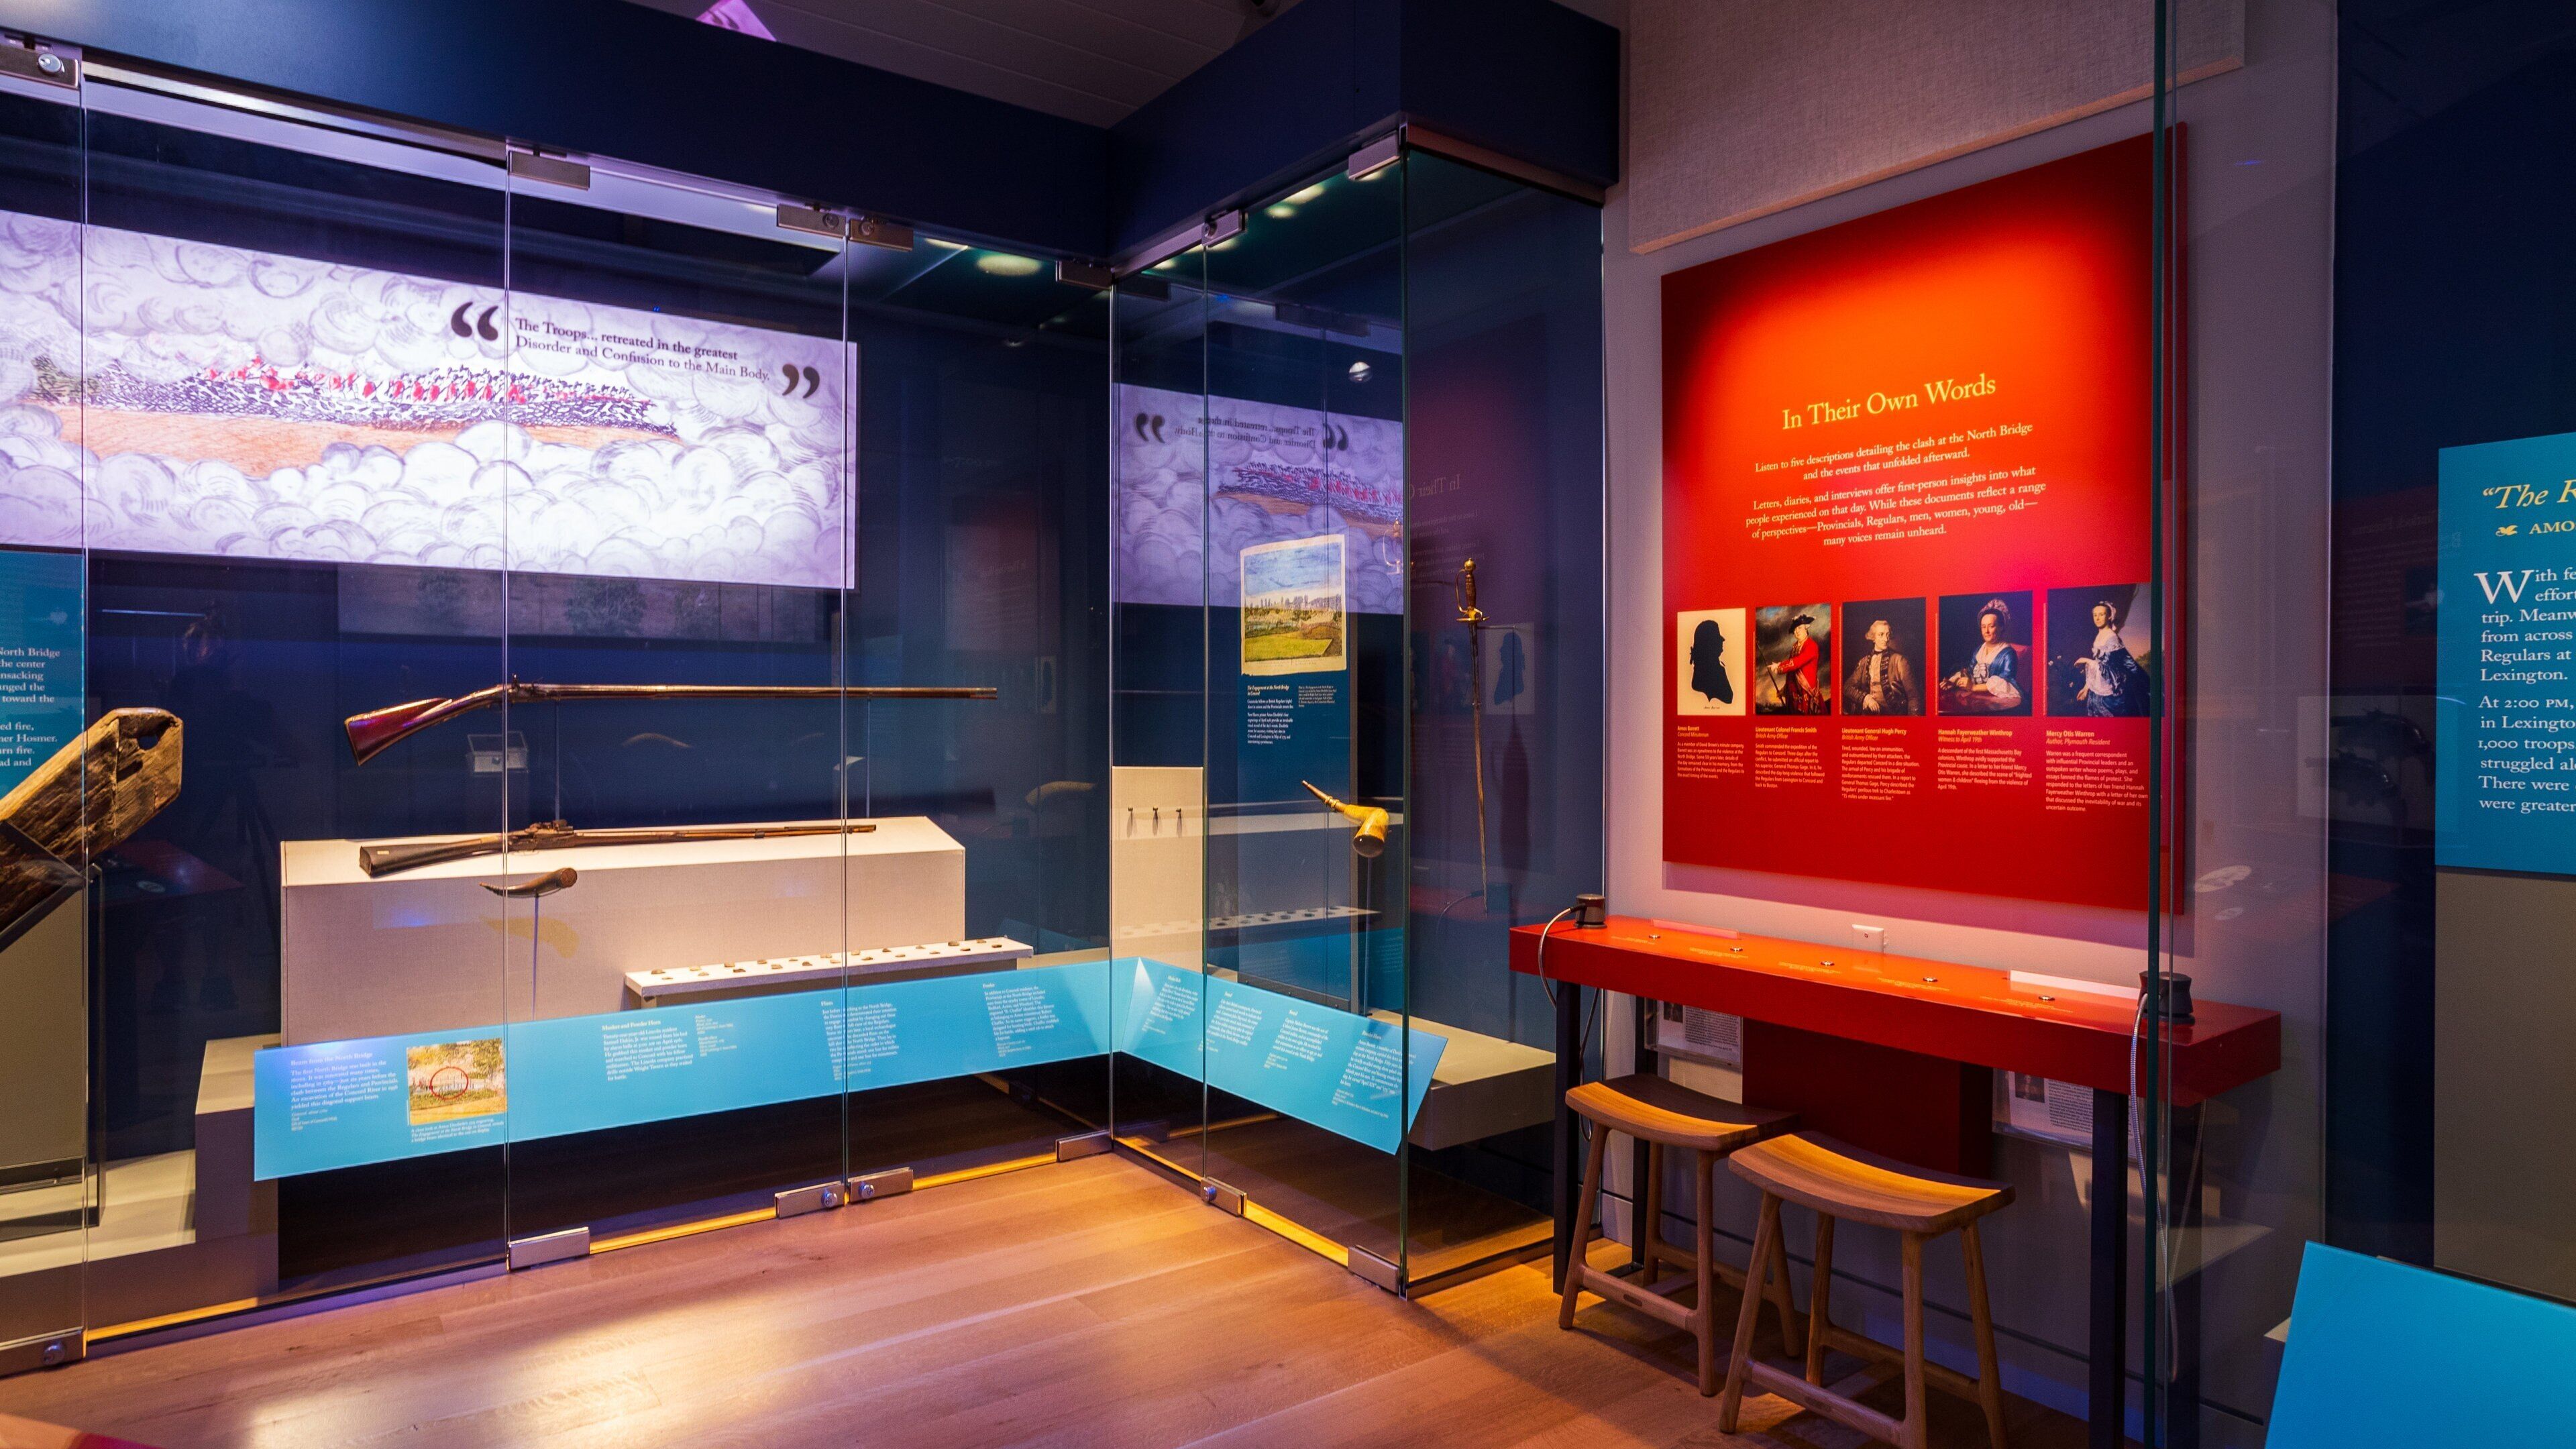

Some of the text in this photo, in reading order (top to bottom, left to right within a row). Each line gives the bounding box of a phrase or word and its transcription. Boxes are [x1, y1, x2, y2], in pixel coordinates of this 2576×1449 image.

[515, 317, 737, 360] The Troops... retreated in the greatest
[516, 334, 769, 382] Disorder and Confusion to the Main Body.
[1782, 372, 1995, 429] In Their Own Words
[1756, 462, 1778, 472] Listen
[1790, 457, 1804, 467] five
[1806, 451, 1854, 464] descriptions
[1856, 444, 1893, 457] detailing
[1896, 441, 1910, 451] the
[1912, 436, 1935, 449] clash
[1937, 437, 1946, 445] at
[1949, 433, 1964, 443] the
[1967, 427, 1996, 441] North
[2000, 422, 2033, 435] Bridge
[1803, 447, 1970, 480] and the events that unfolded afterward.
[1754, 466, 2036, 510] Letters, diaries, and interviews offer first-person insights into what
[1746, 513, 1769, 527] people
[1771, 507, 1817, 523] experienced
[1831, 504, 1847, 515] that
[1849, 502, 1866, 515] day.
[1868, 498, 1896, 510] While
[1899, 496, 1922, 506] these
[1924, 491, 1974, 504] documents
[1977, 486, 2006, 498] reflect
[2018, 483, 2046, 494] range
[1752, 529, 1760, 538] of
[1866, 514, 1907, 527] Regulars,
[1909, 513, 1931, 521] men,
[1934, 508, 1970, 518] women,
[1973, 504, 2006, 517] young,
[2008, 498, 2038, 511] old—
[1823, 523, 1946, 546] many voices remain unheard.
[2528, 521, 2576, 534] AMO
[2481, 610, 2512, 627] trip.
[2481, 630, 2573, 642] from across
[28, 648, 60, 658] Bridge
[2481, 648, 2571, 665] Regulars at
[0, 659, 13, 667] he
[2481, 668, 2567, 684] Lexington.
[30, 682, 44, 691] the
[1, 694, 54, 702] toward the
[2478, 695, 2574, 710] At 2:00 PM,
[15, 722, 34, 731] fire,
[2481, 716, 2496, 728] in
[17, 733, 57, 742] Hosmer.
[2046, 730, 2062, 738] Mercy
[16, 745, 34, 753] fire.
[2478, 740, 2518, 750] 1,000
[13, 757, 31, 766] and
[2480, 757, 2576, 772] struggled al
[2478, 775, 2569, 790] There were
[2479, 800, 2515, 809] were
